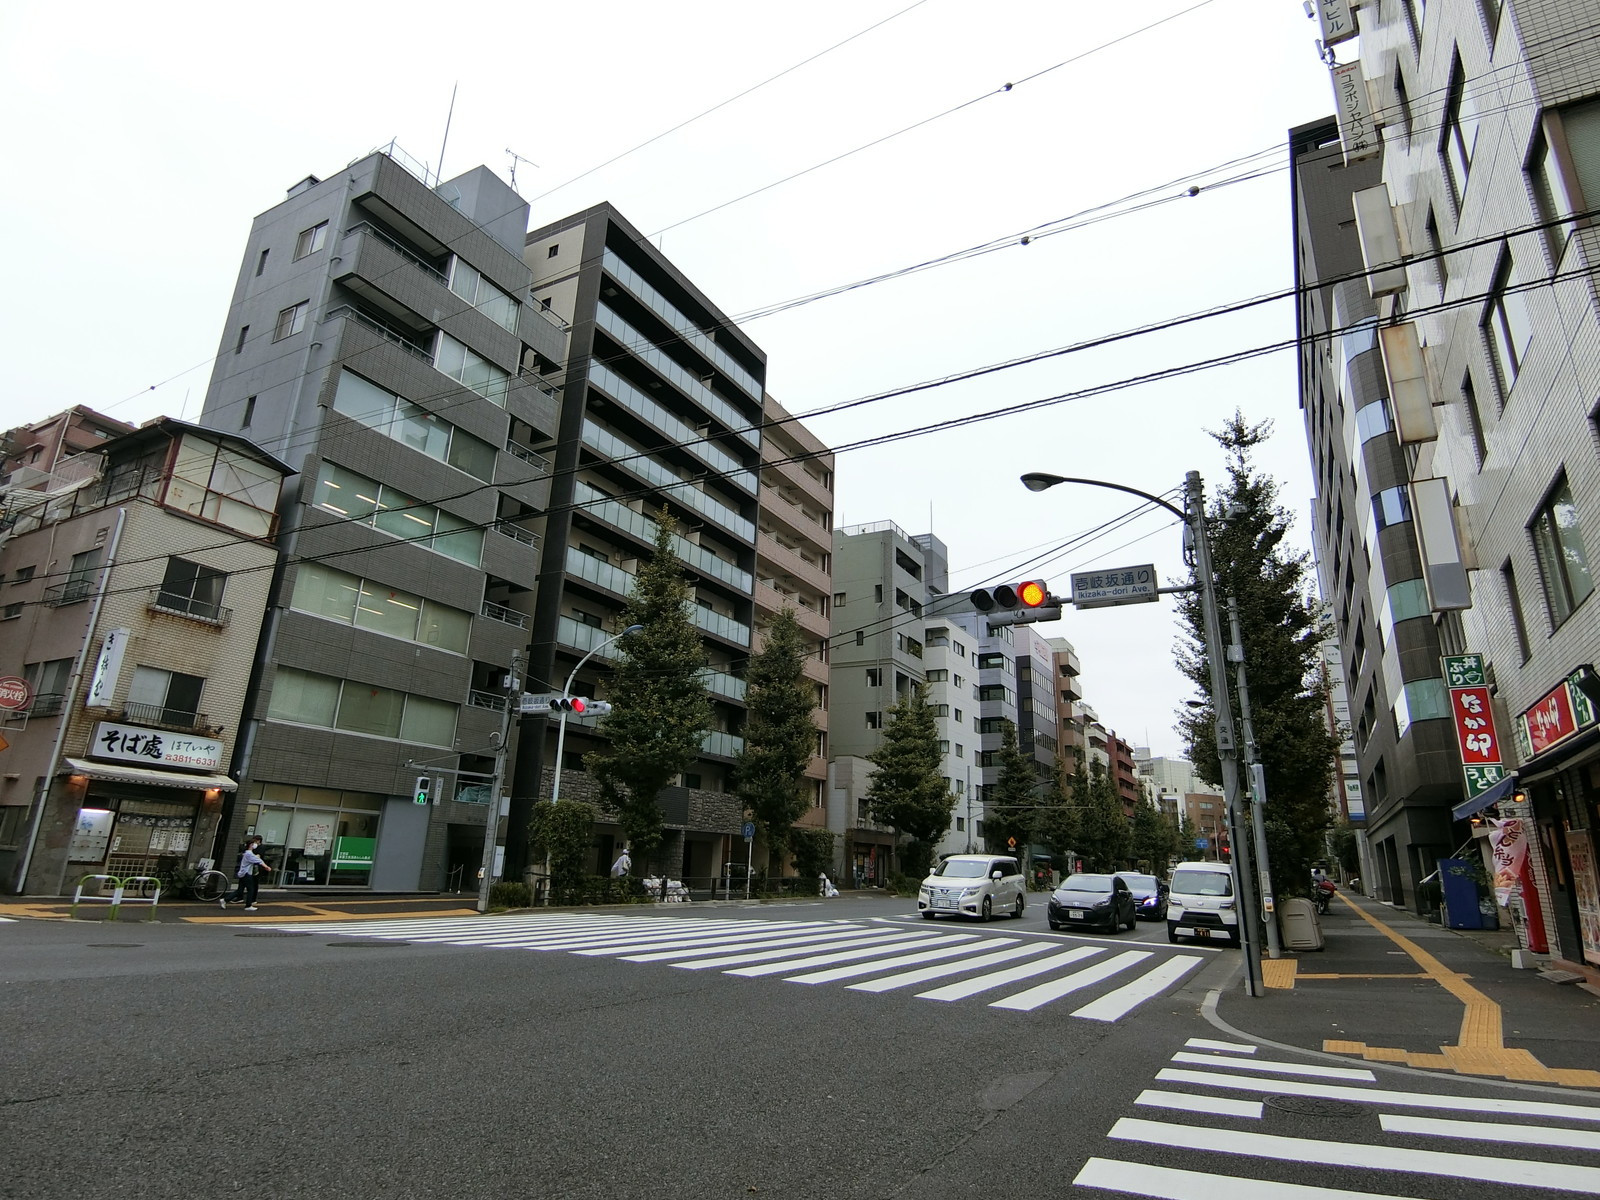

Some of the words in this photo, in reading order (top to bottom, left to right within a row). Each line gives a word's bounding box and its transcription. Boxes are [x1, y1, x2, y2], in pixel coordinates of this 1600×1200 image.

[1075, 570, 1150, 591] 壱岐坂通り
[1078, 587, 1128, 599] Ikizaka-dori
[1131, 585, 1151, 593] Ave.
[1460, 692, 1492, 759] なか卯
[173, 754, 217, 767] 3811-6331
